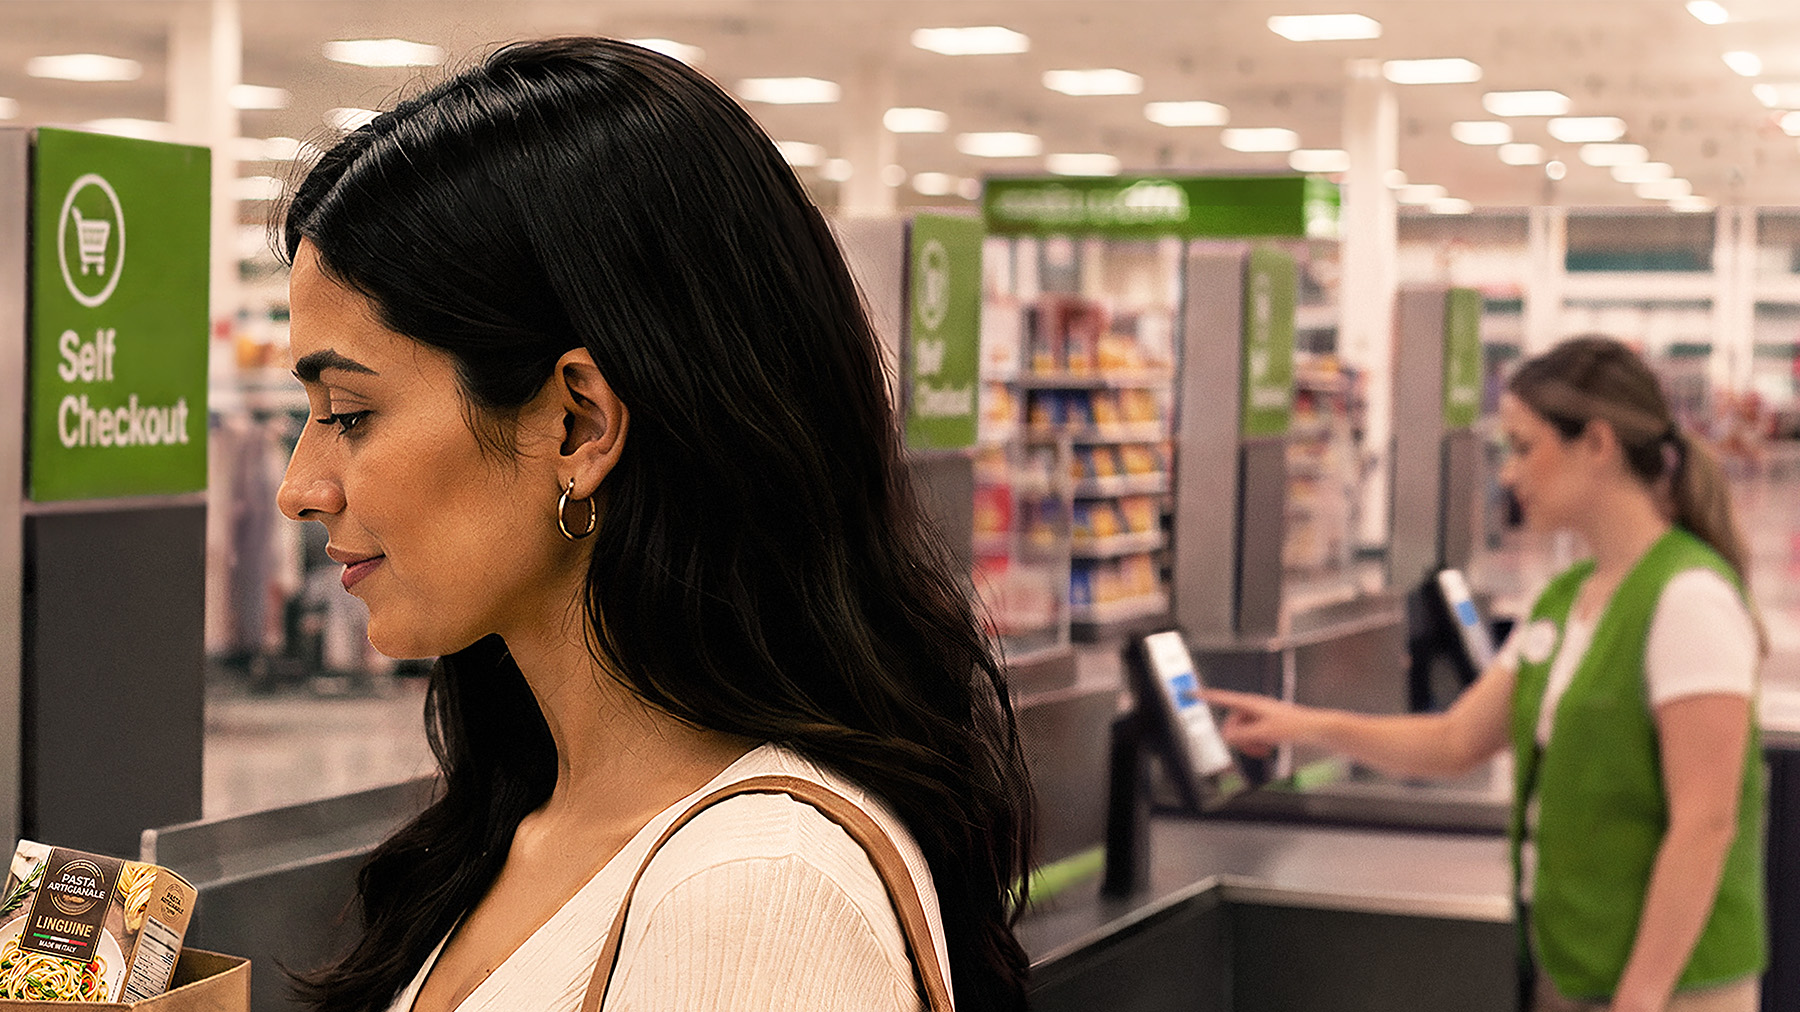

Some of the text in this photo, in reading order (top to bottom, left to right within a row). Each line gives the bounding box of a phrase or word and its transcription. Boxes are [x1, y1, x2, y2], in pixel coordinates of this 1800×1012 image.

[57, 328, 117, 383] Self
[57, 393, 189, 449] Checkout
[46, 881, 106, 900] ARTIGIANALE
[61, 873, 96, 889] PASTA
[35, 915, 94, 938] LINGUINE
